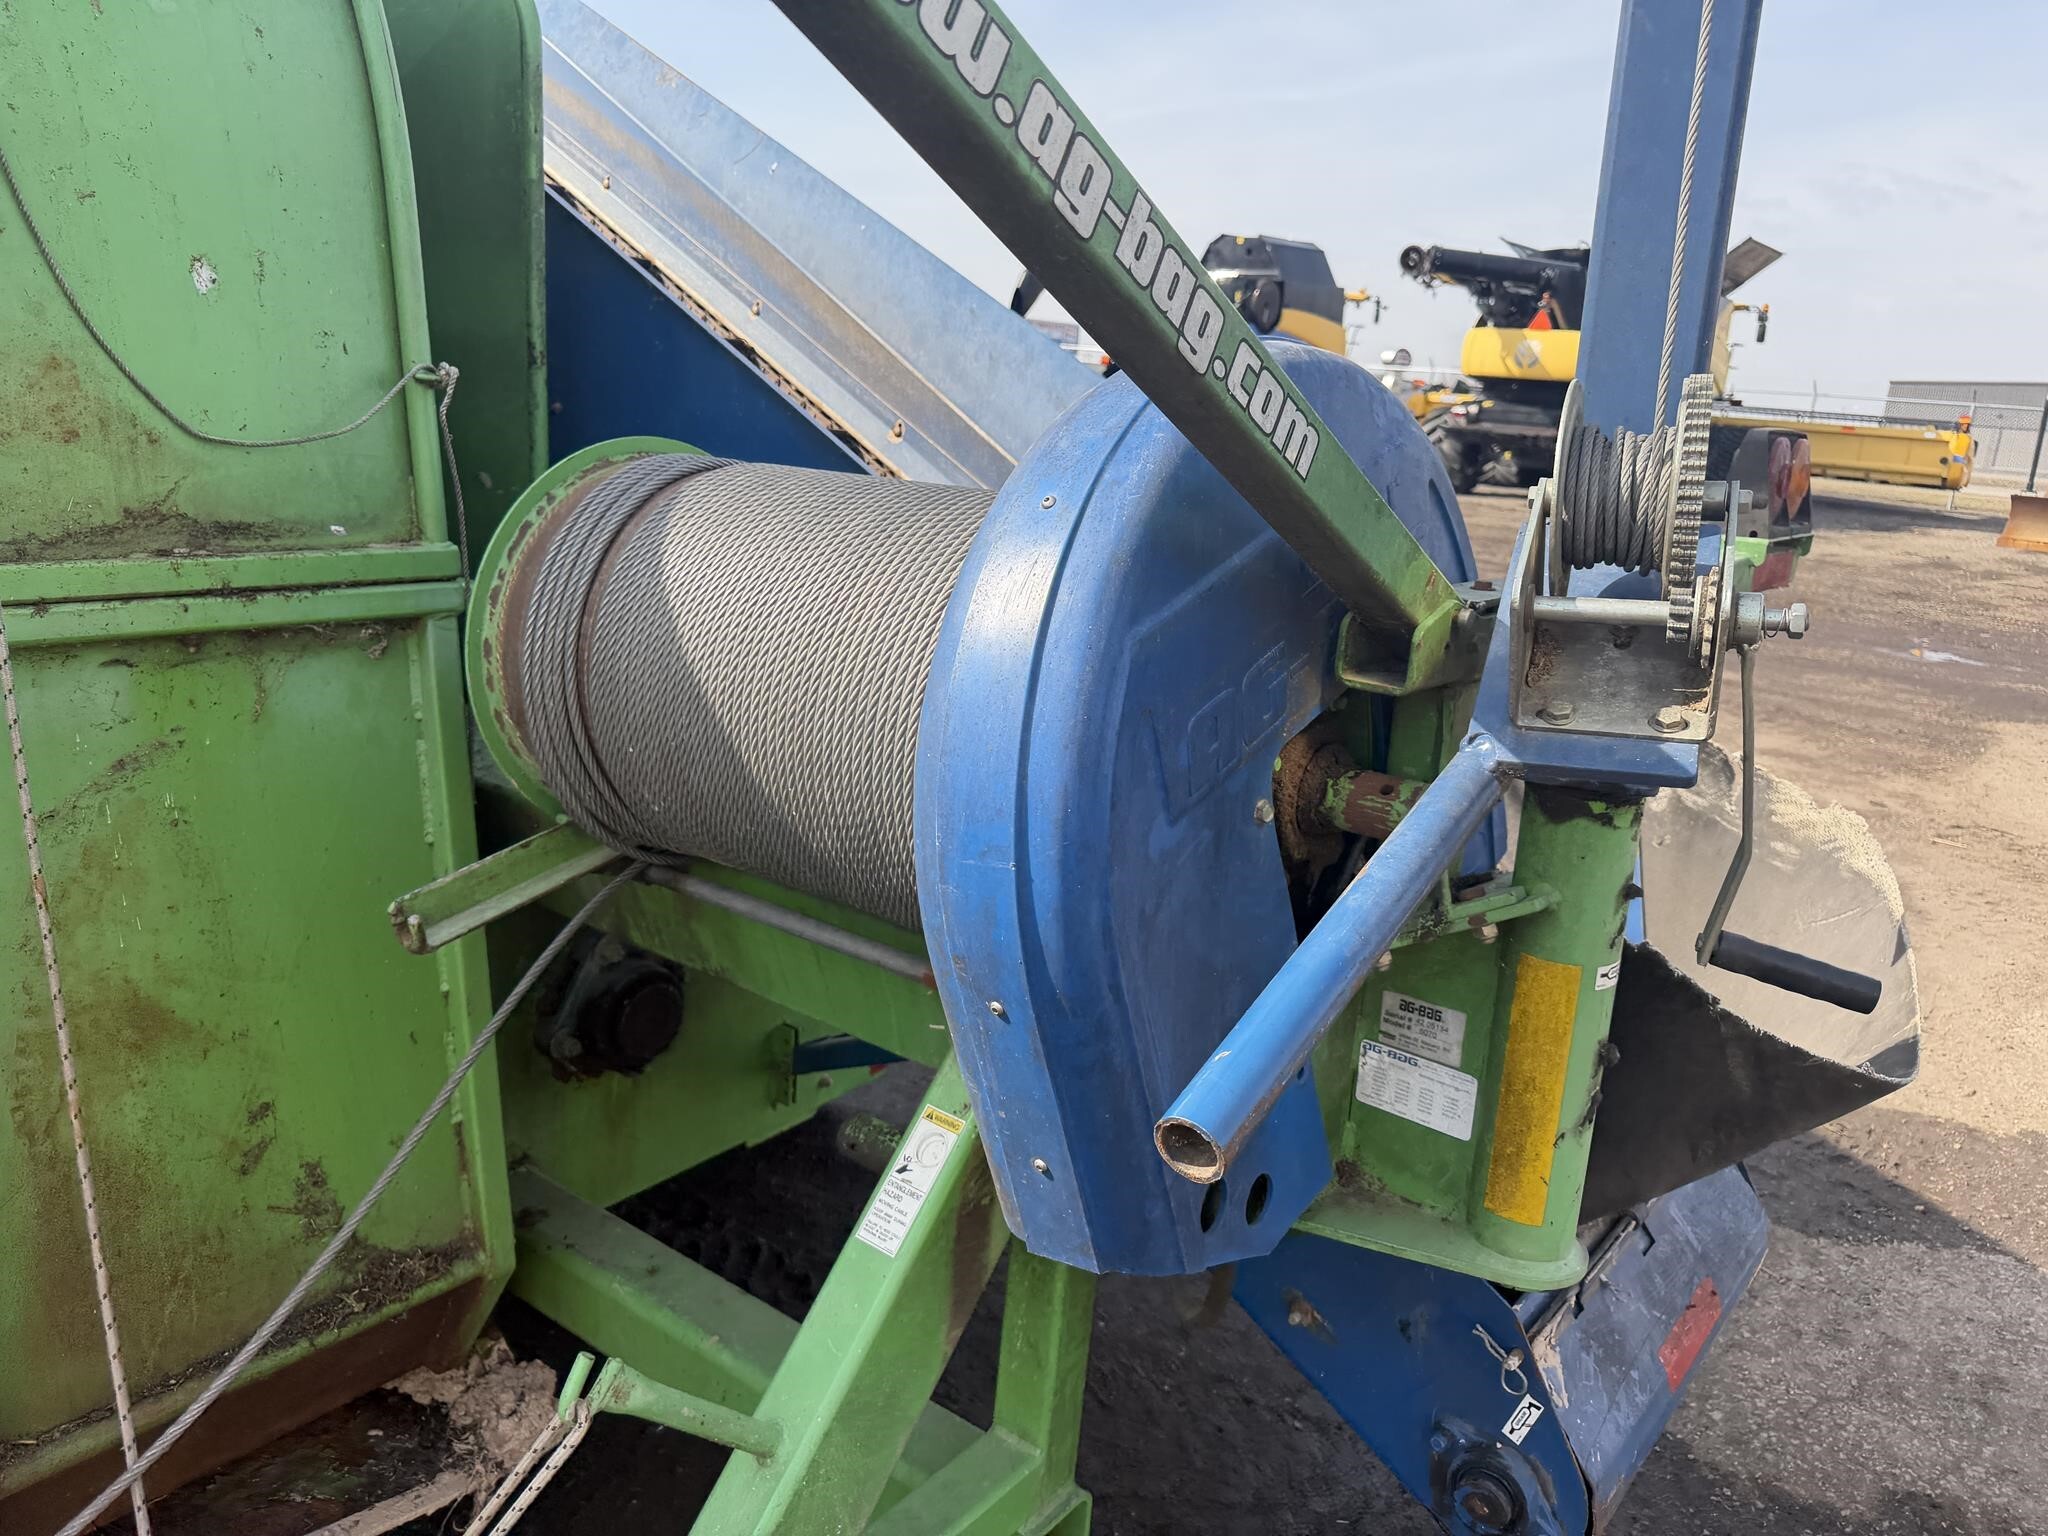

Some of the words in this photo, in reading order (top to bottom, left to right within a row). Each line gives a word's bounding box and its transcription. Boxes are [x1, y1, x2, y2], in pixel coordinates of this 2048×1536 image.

[905, 0, 1320, 481] w.ag-bag.com
[934, 1115, 960, 1131] WARNING
[883, 1188, 903, 1203] HAZARD
[887, 1178, 923, 1201] ENTANGLEMENT
